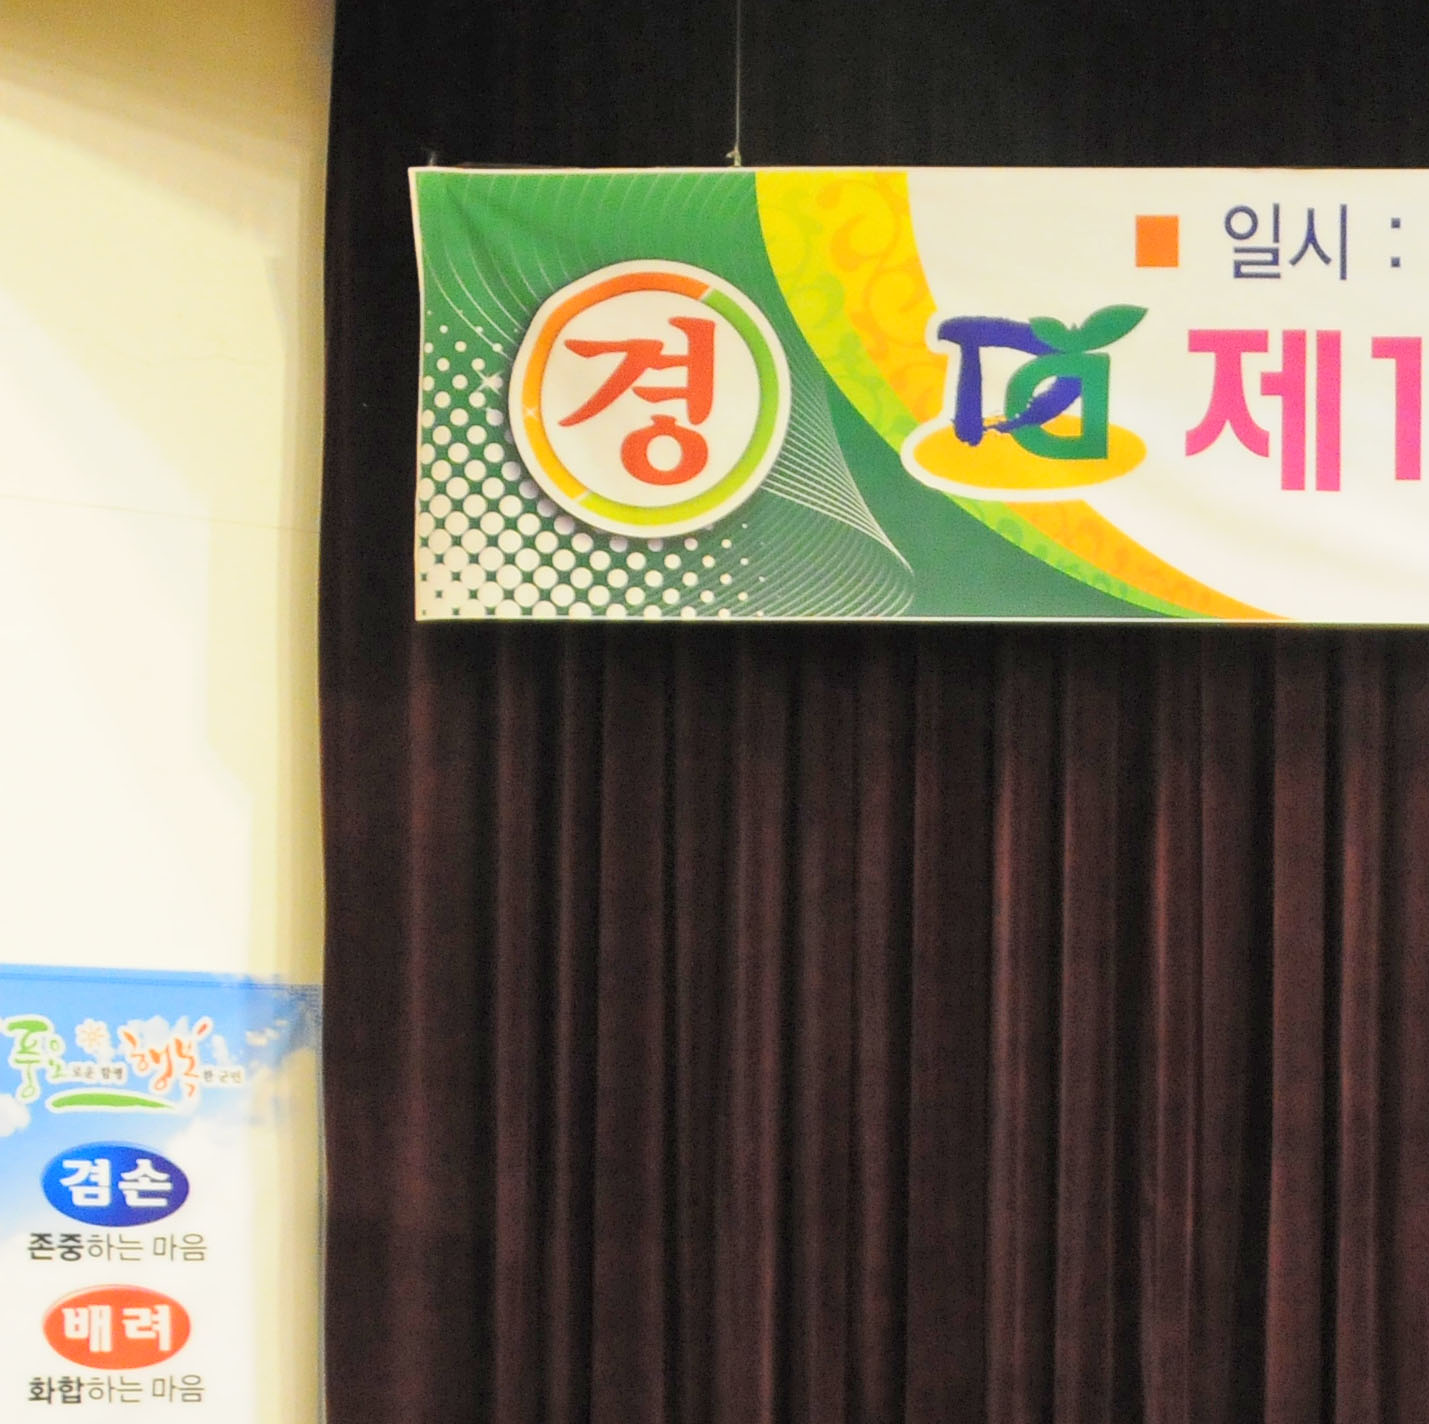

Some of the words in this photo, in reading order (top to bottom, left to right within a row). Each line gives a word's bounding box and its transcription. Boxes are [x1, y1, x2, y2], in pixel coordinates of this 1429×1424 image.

[1223, 202, 1349, 281] 일시
[558, 316, 716, 486] 경
[60, 1158, 173, 1207] 겸손
[28, 1232, 144, 1262] 존중하는
[153, 1232, 208, 1262] 마음
[61, 1303, 172, 1353] 배려
[28, 1374, 143, 1405] 화합하는
[152, 1374, 205, 1403] 마음
